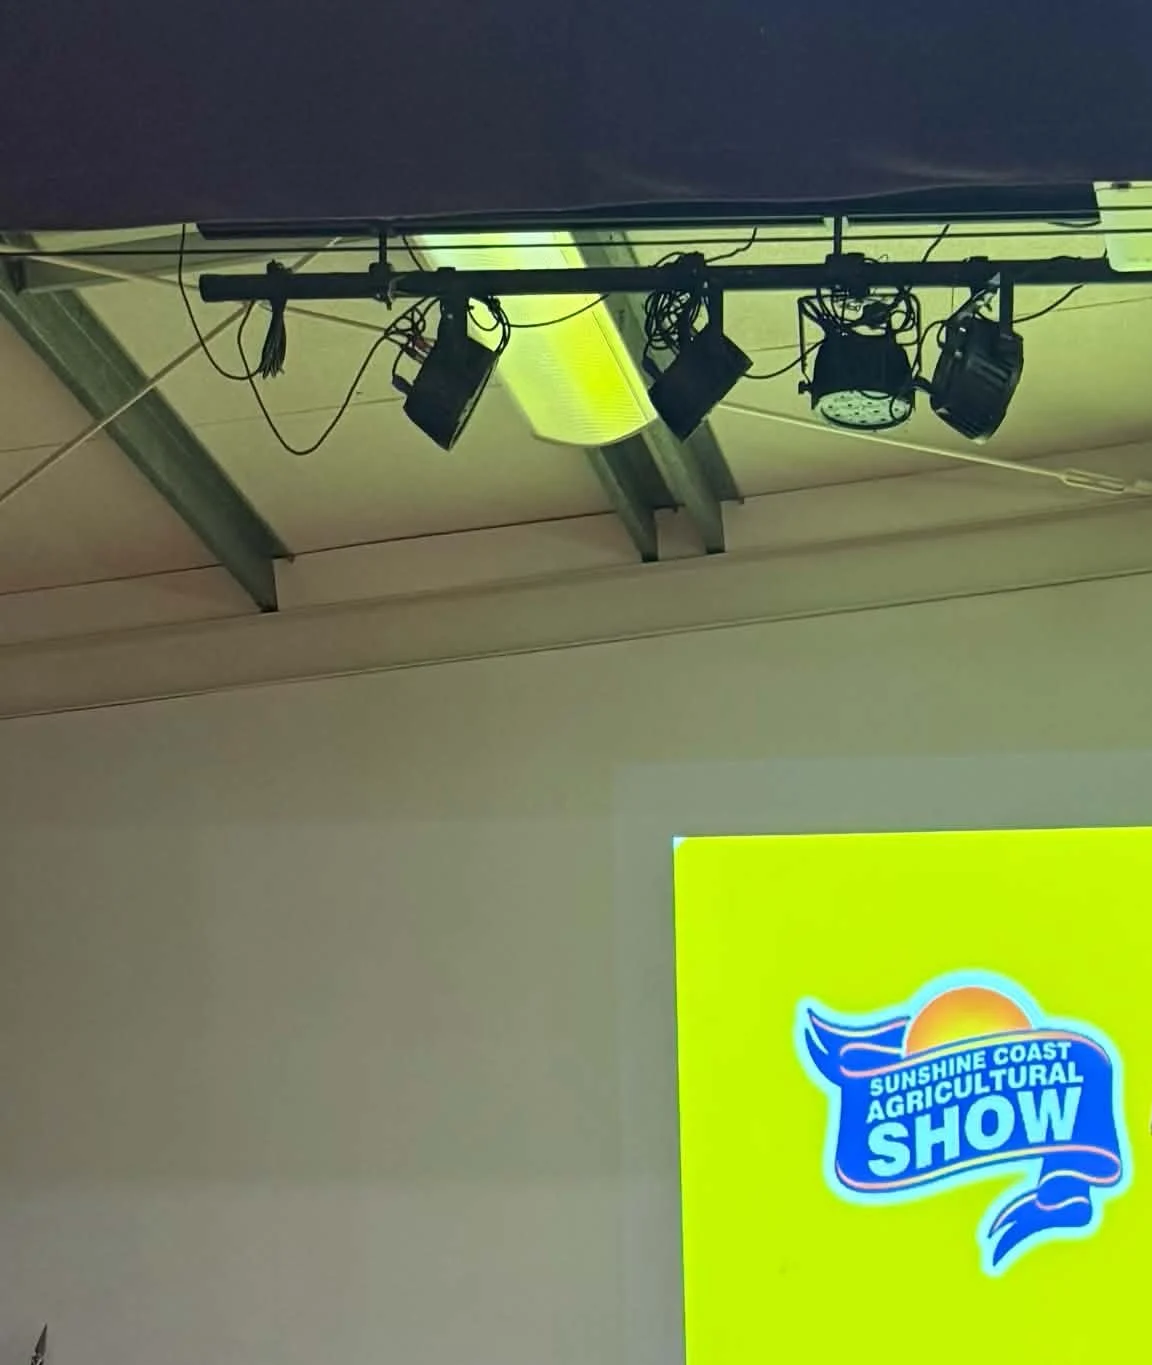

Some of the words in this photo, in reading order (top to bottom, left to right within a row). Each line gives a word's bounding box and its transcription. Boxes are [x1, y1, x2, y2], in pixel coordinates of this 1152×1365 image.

[866, 1061, 1084, 1124] AGRICULTURAL
[869, 1050, 986, 1097] SUNSHINE
[992, 1042, 1072, 1065] COAST
[867, 1086, 1082, 1177] SHOW
